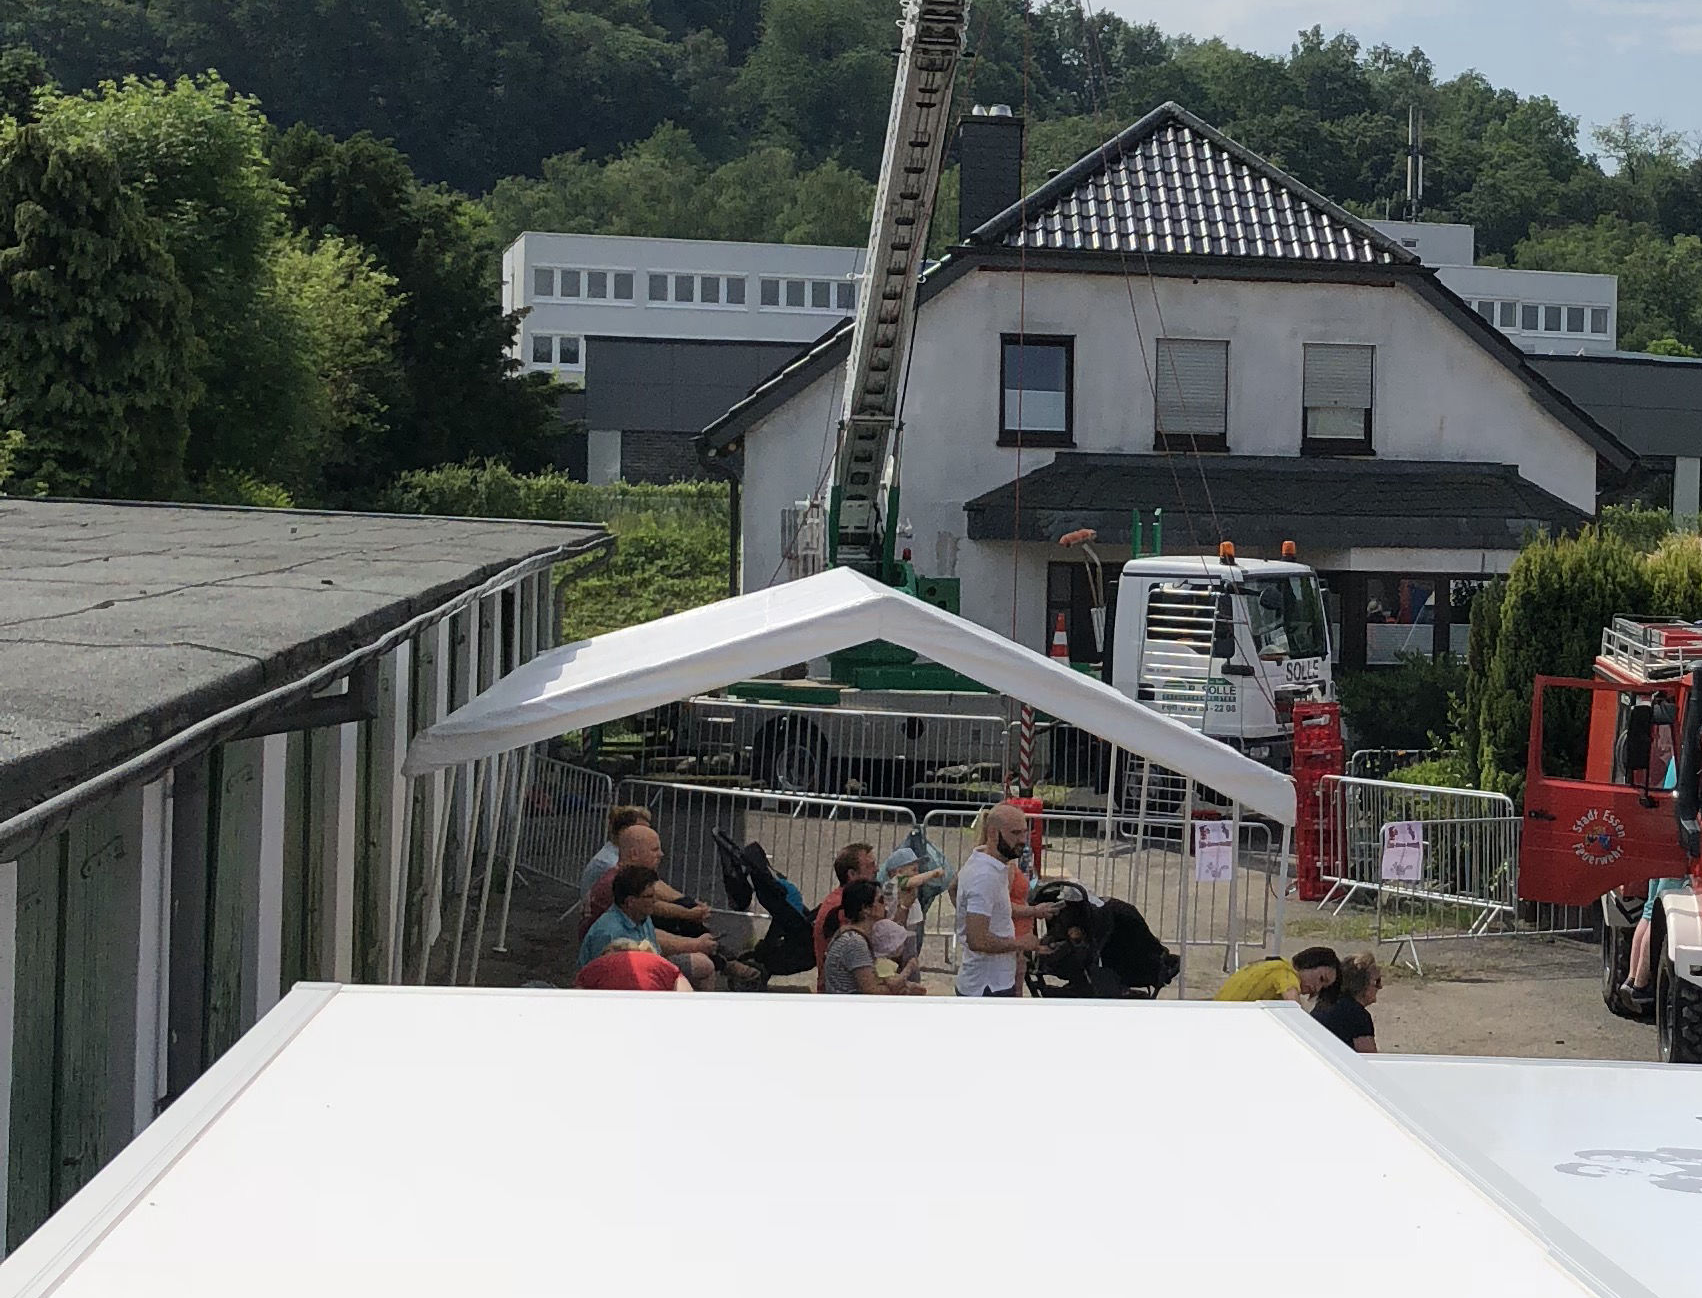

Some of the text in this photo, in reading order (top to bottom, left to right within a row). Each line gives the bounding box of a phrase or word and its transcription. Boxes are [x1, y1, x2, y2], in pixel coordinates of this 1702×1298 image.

[1285, 659, 1319, 682] SOLLE
[1572, 809, 1626, 838] Stadt Essen
[1572, 843, 1625, 865] Feuerwehr
